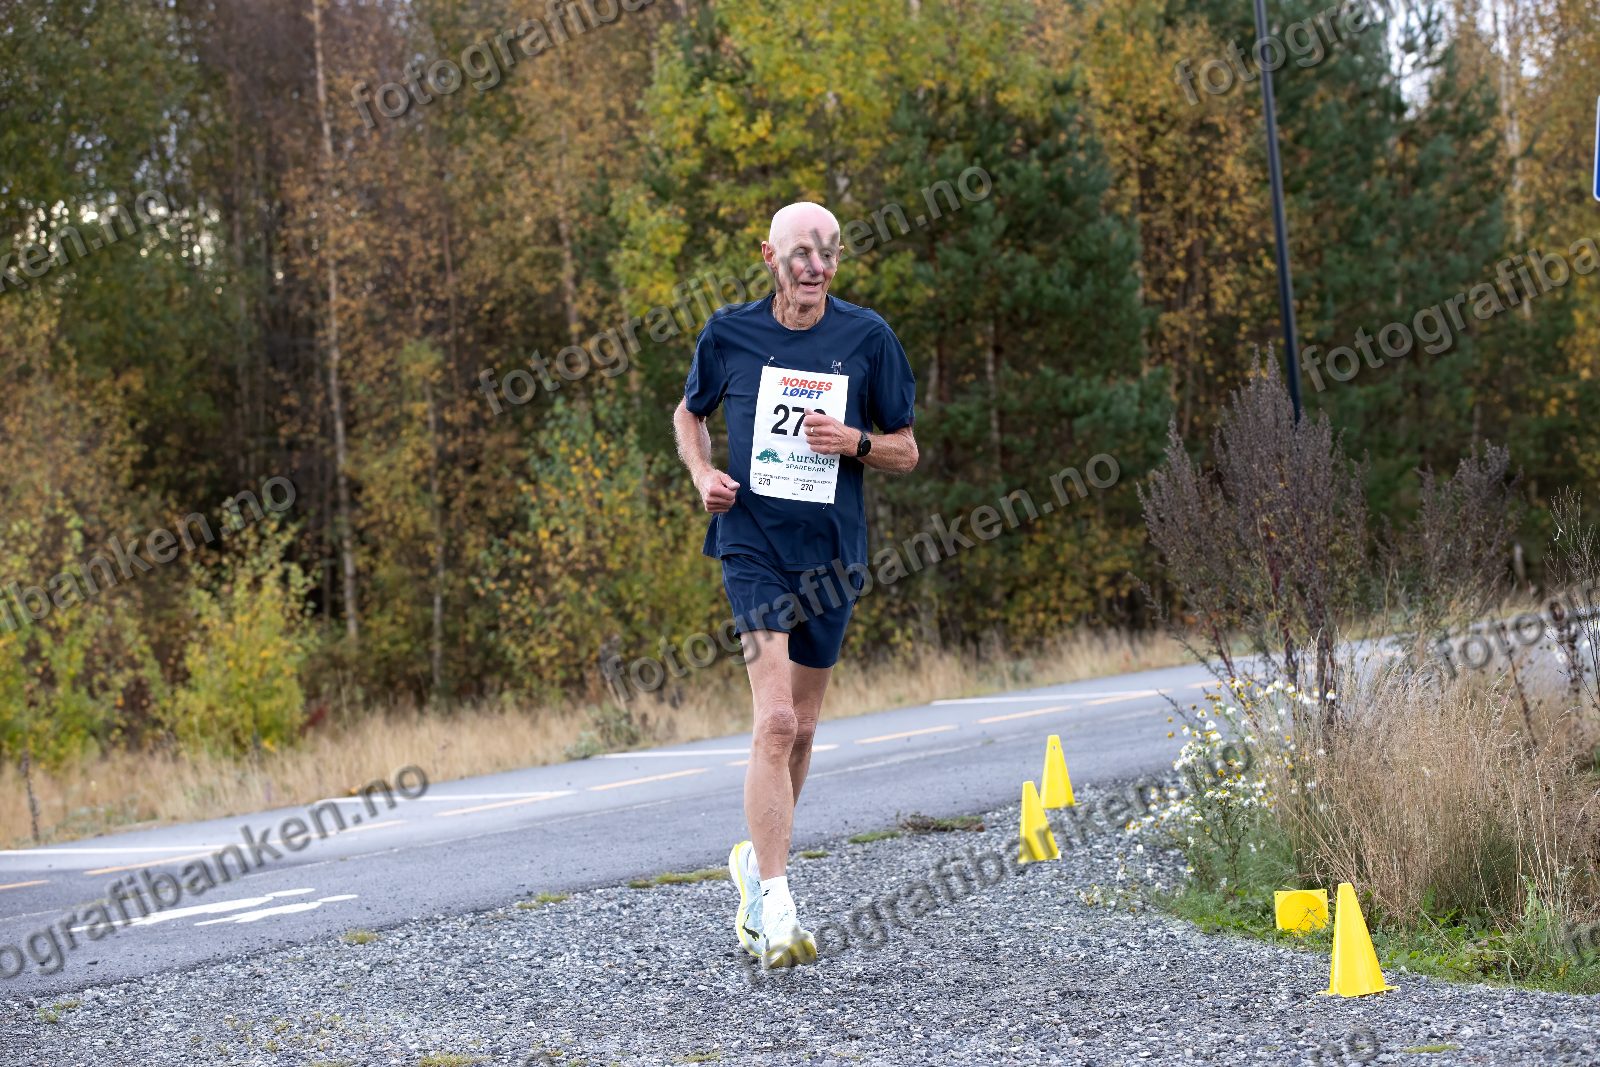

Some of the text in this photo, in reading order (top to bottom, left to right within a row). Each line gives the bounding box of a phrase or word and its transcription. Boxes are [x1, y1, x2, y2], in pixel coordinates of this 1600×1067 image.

[780, 377, 833, 391] NORGES
[782, 387, 823, 400] LØPET
[771, 404, 826, 437] 27
[787, 451, 836, 469] Aurskog
[785, 463, 826, 473] SPAREBANK
[800, 483, 814, 492] 270
